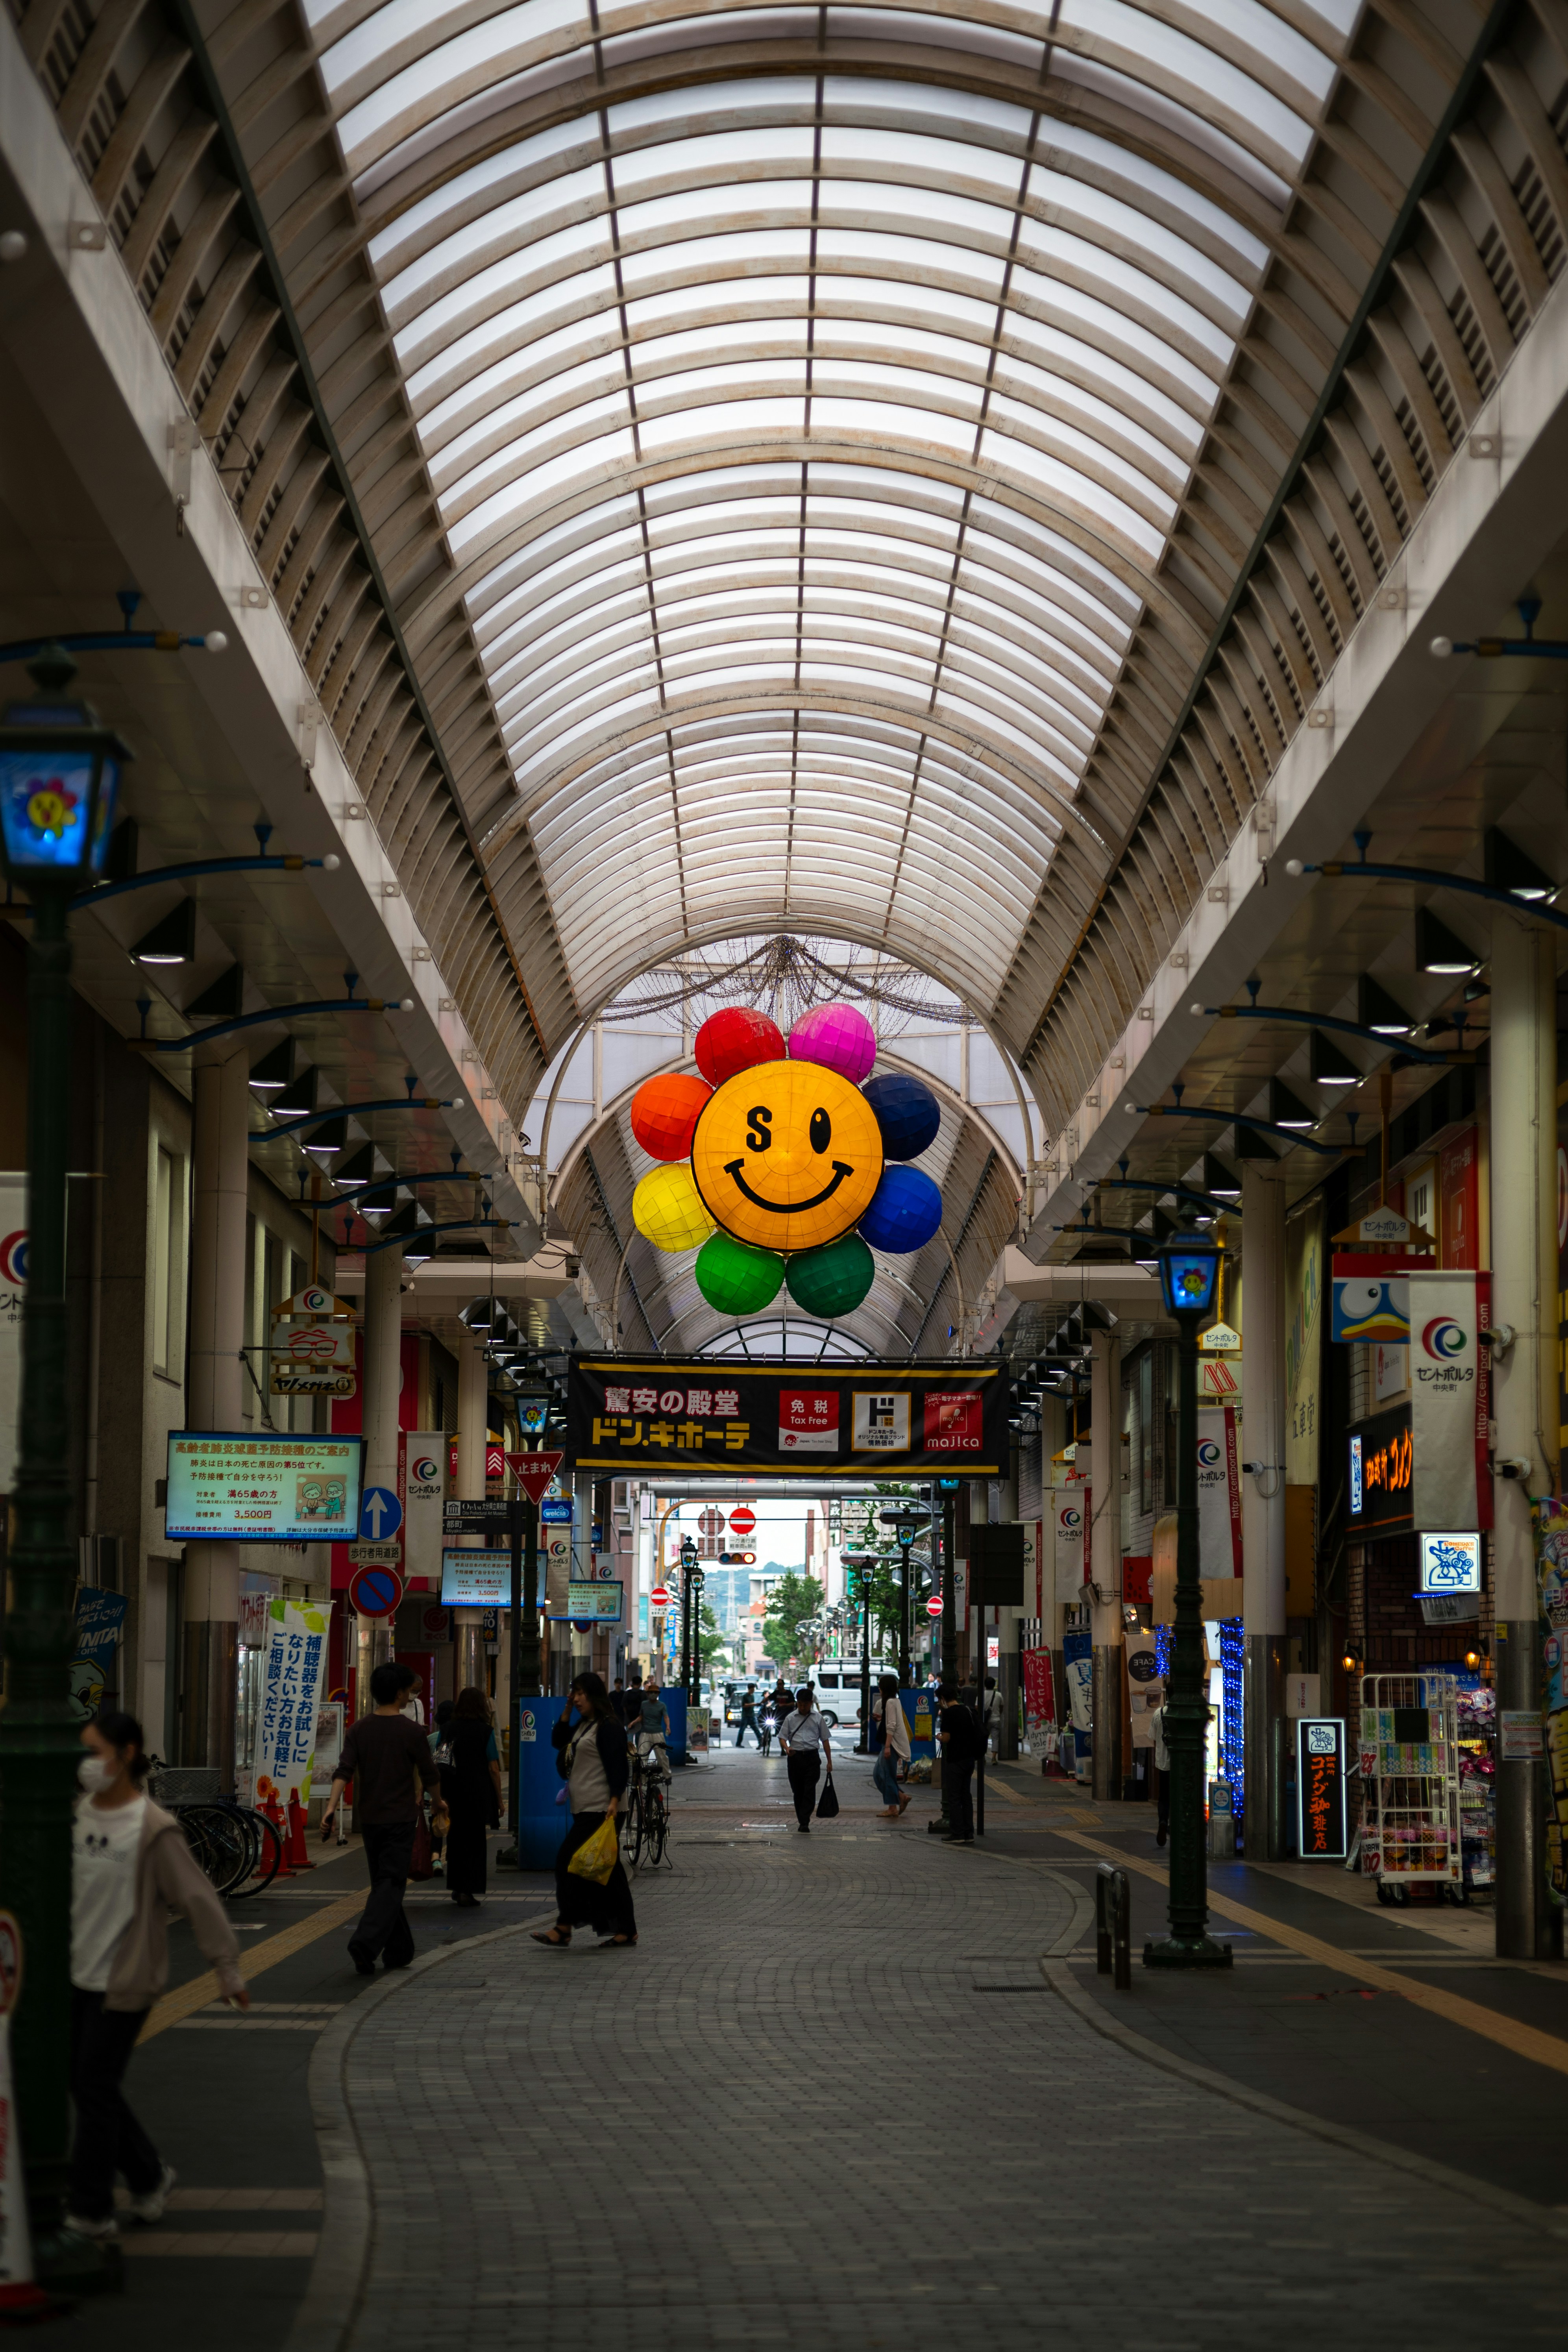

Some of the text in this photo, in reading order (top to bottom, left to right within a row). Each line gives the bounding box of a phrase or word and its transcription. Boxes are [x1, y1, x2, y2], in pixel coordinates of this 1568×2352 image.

[1364, 1220, 1406, 1232] セントポルタ
[1206, 1334, 1237, 1342] セントポルタ
[1417, 1366, 1474, 1382] セントポルタ
[1433, 1383, 1457, 1392] 中央町
[605, 1387, 739, 1416] 驚安の殿堂
[176, 1442, 349, 1457] 高齢者肺炎球菌予防接種のご案内
[190, 1459, 325, 1470] 肺炎は日本の死亡原因の第5位です。
[517, 1461, 552, 1474] 止まれ
[190, 1472, 282, 1482] 予防接種で自分を守ろう!
[1229, 1428, 1239, 1518] http://centporta.com
[227, 1489, 278, 1498] 満65歳の方
[409, 1485, 441, 1494] セントポルタ
[481, 1502, 507, 1511] 大分県立美術館
[234, 1510, 272, 1519] 3,500円
[446, 1520, 463, 1529] 都町
[351, 1548, 399, 1559] 歩行者用道路
[292, 1635, 322, 1763] 補聴器をお試しに
[273, 1634, 303, 1778] なりたい方お気軽に
[1309, 1757, 1331, 1851] コメダ珈琲店
